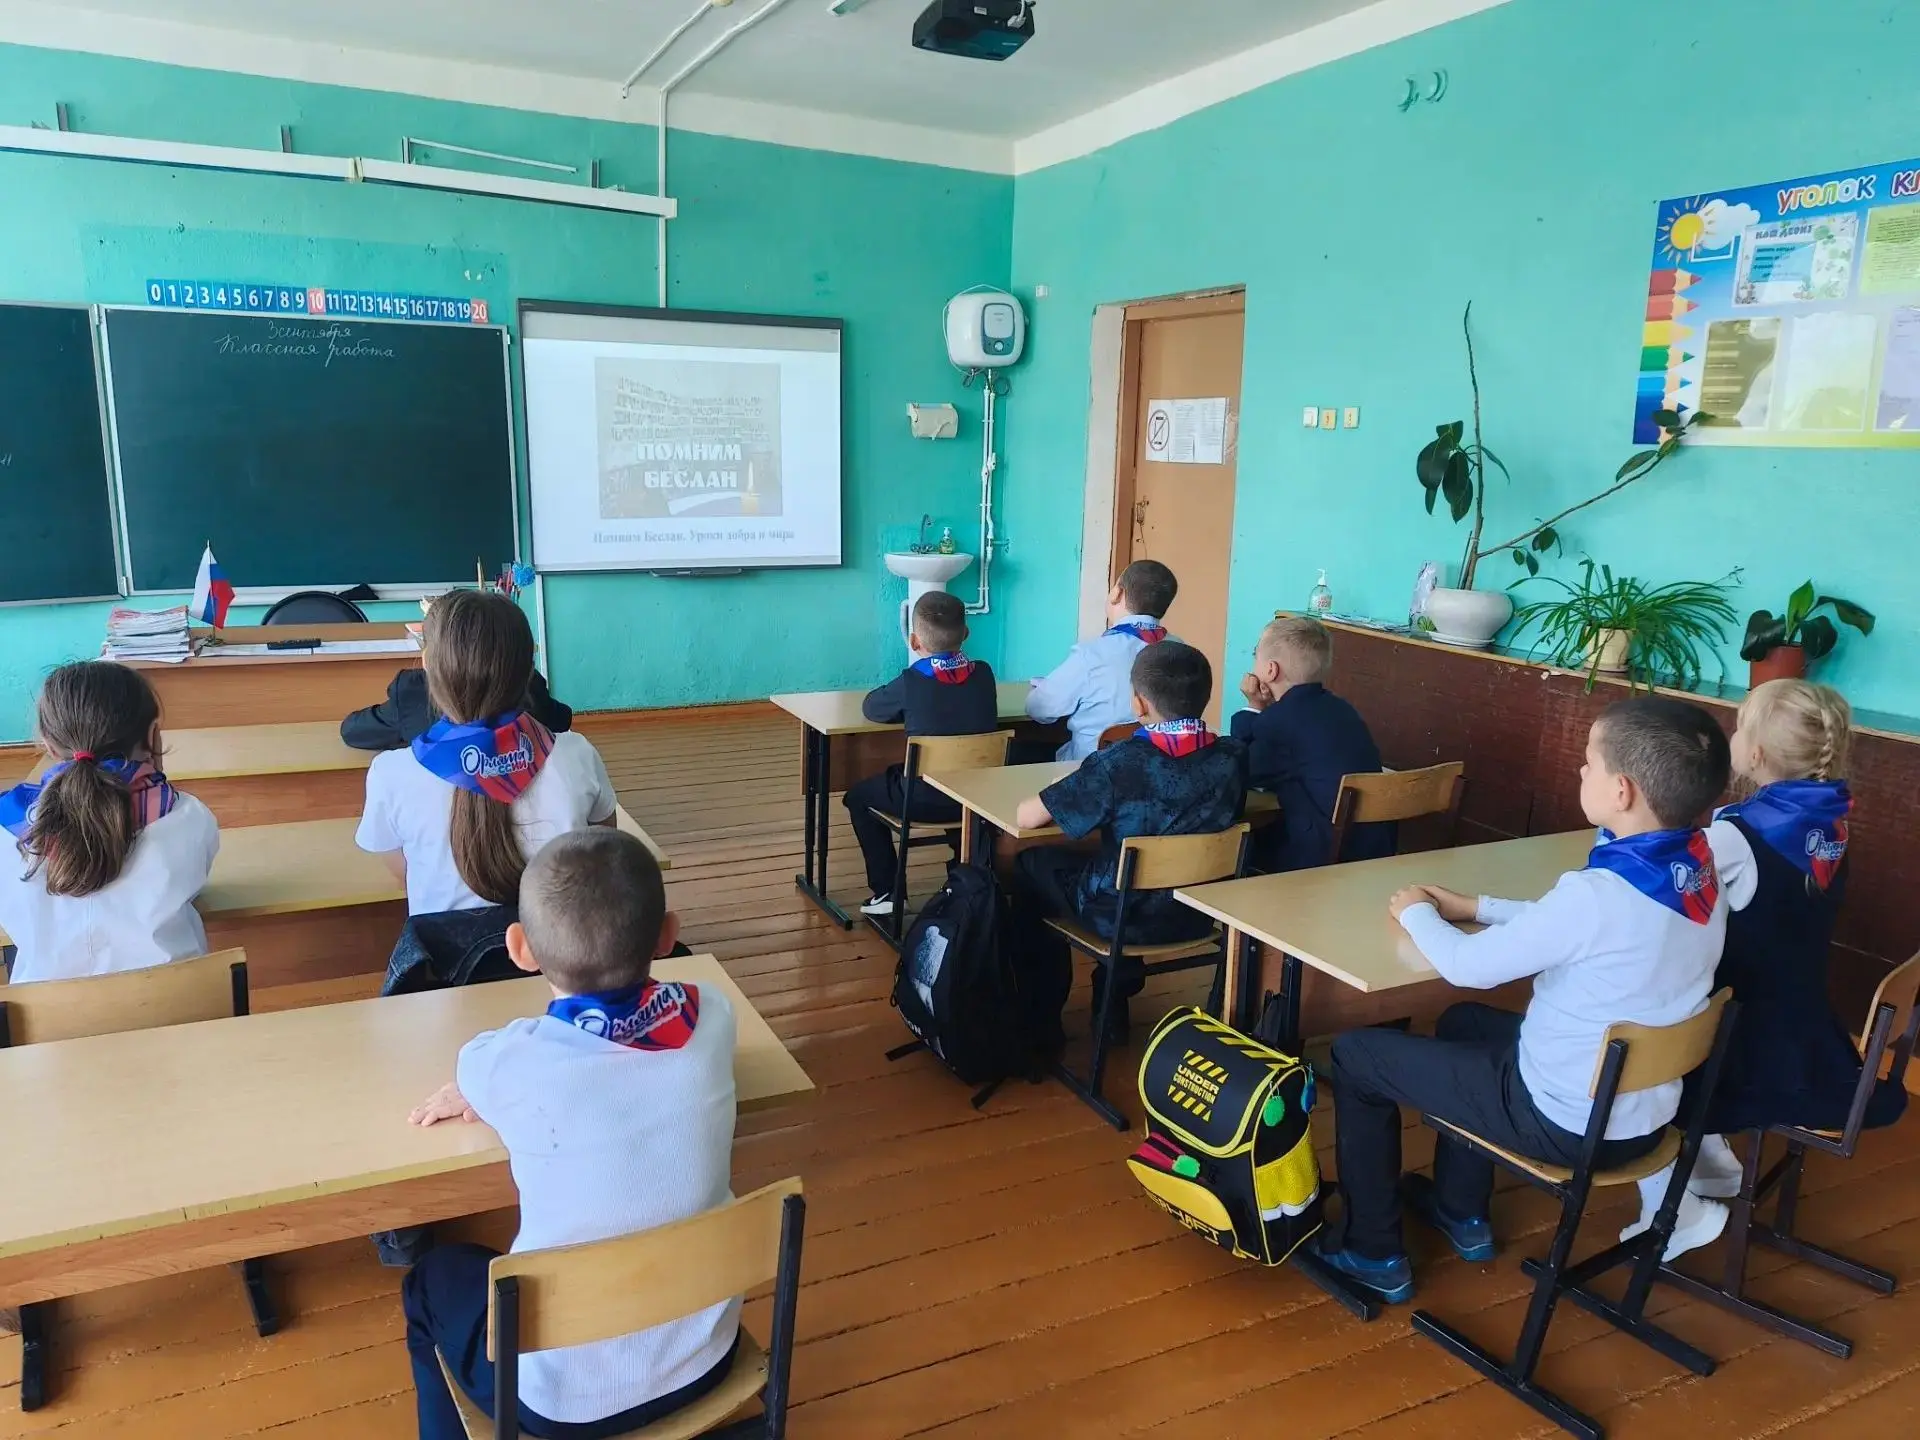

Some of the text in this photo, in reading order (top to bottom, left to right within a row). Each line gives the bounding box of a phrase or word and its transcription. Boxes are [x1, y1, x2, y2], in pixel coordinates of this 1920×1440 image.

[1778, 175, 1876, 215] УГОЛОК
[151, 284, 487, 320] 0 1 2 3 4 5 6 7 8 9 10 11 12 13 14 15 16 17 18 19 20
[214, 334, 396, 368] Классная работа
[637, 442, 742, 461] ПОМНИМ
[644, 470, 738, 489] БЕСЛАН
[1177, 1063, 1220, 1096] UNDER
